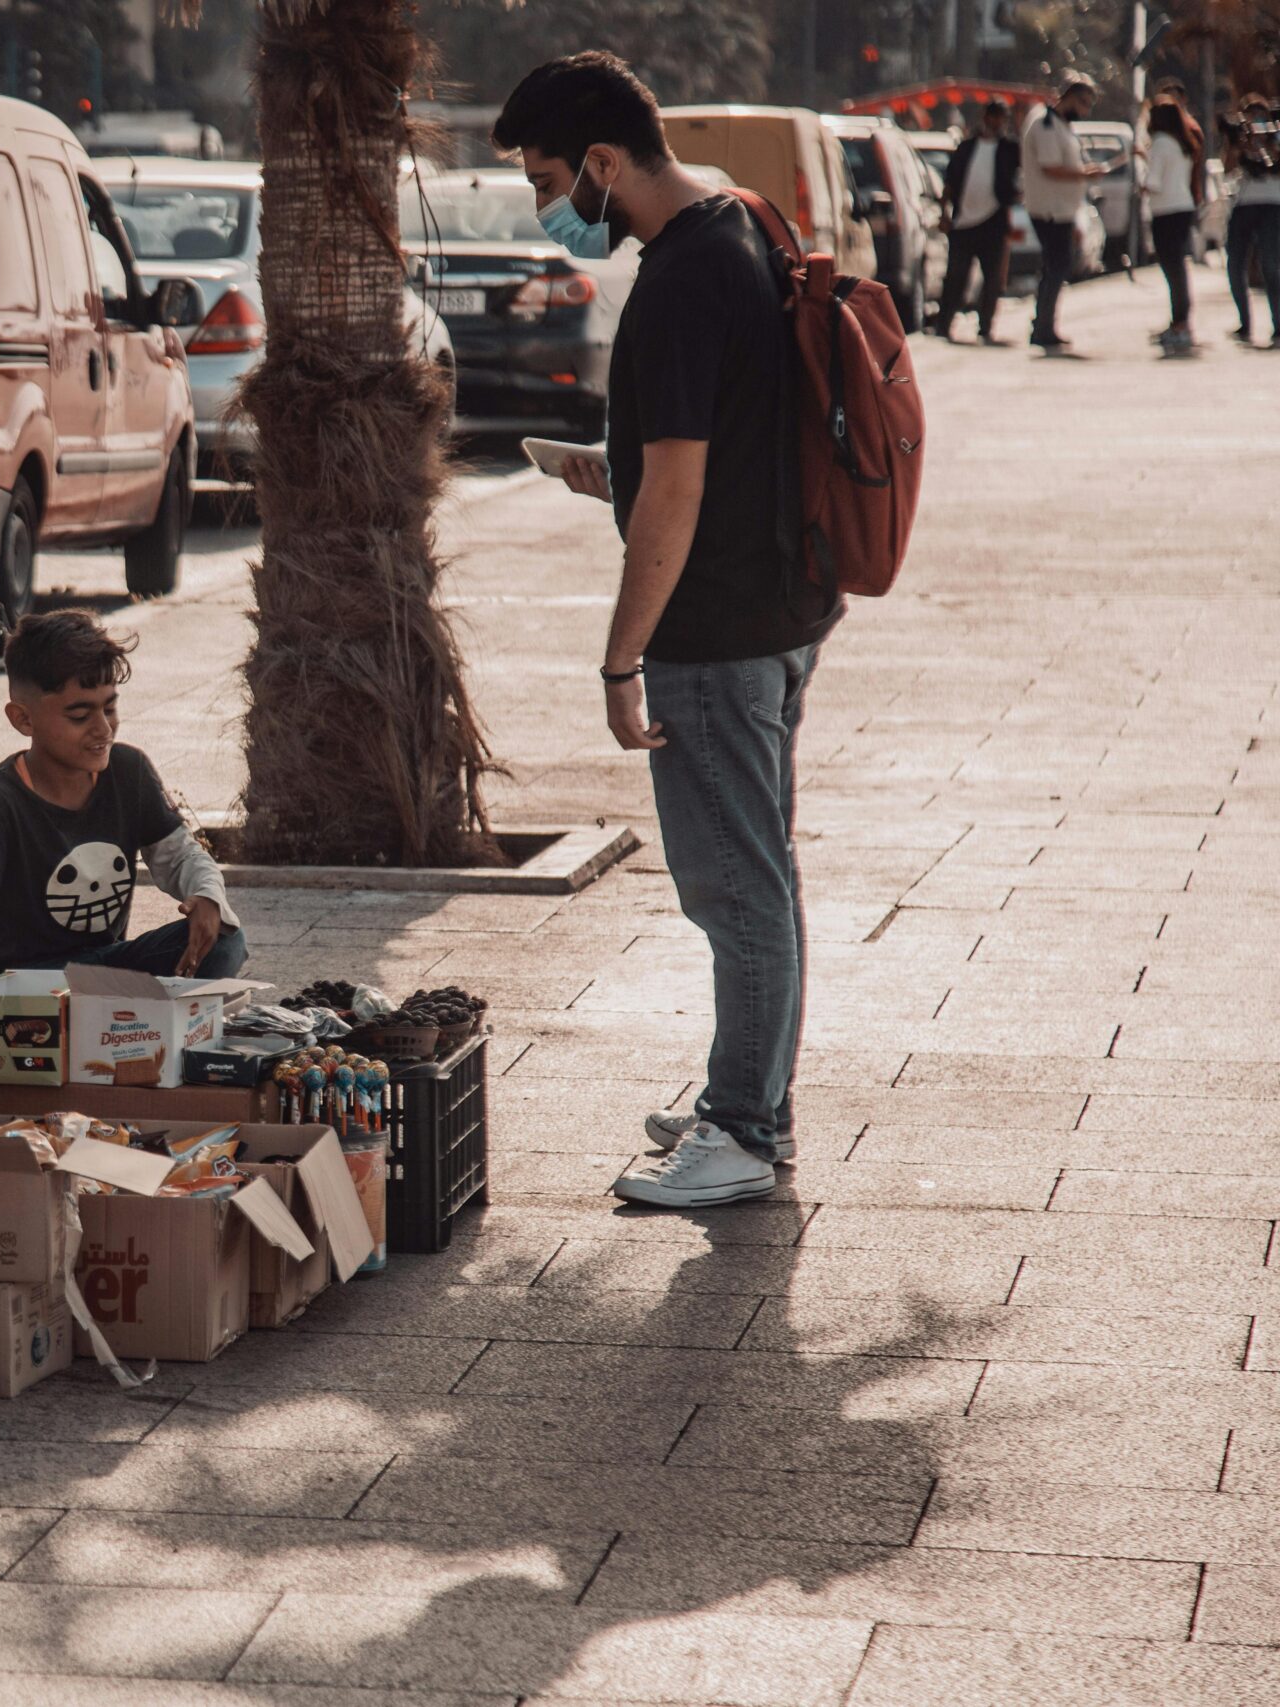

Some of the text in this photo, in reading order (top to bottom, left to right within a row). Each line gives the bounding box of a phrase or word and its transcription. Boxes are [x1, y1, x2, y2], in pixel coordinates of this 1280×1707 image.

[110, 1022, 149, 1032] Biscotino
[100, 1030, 161, 1047] Digestives
[84, 1267, 148, 1323] er
